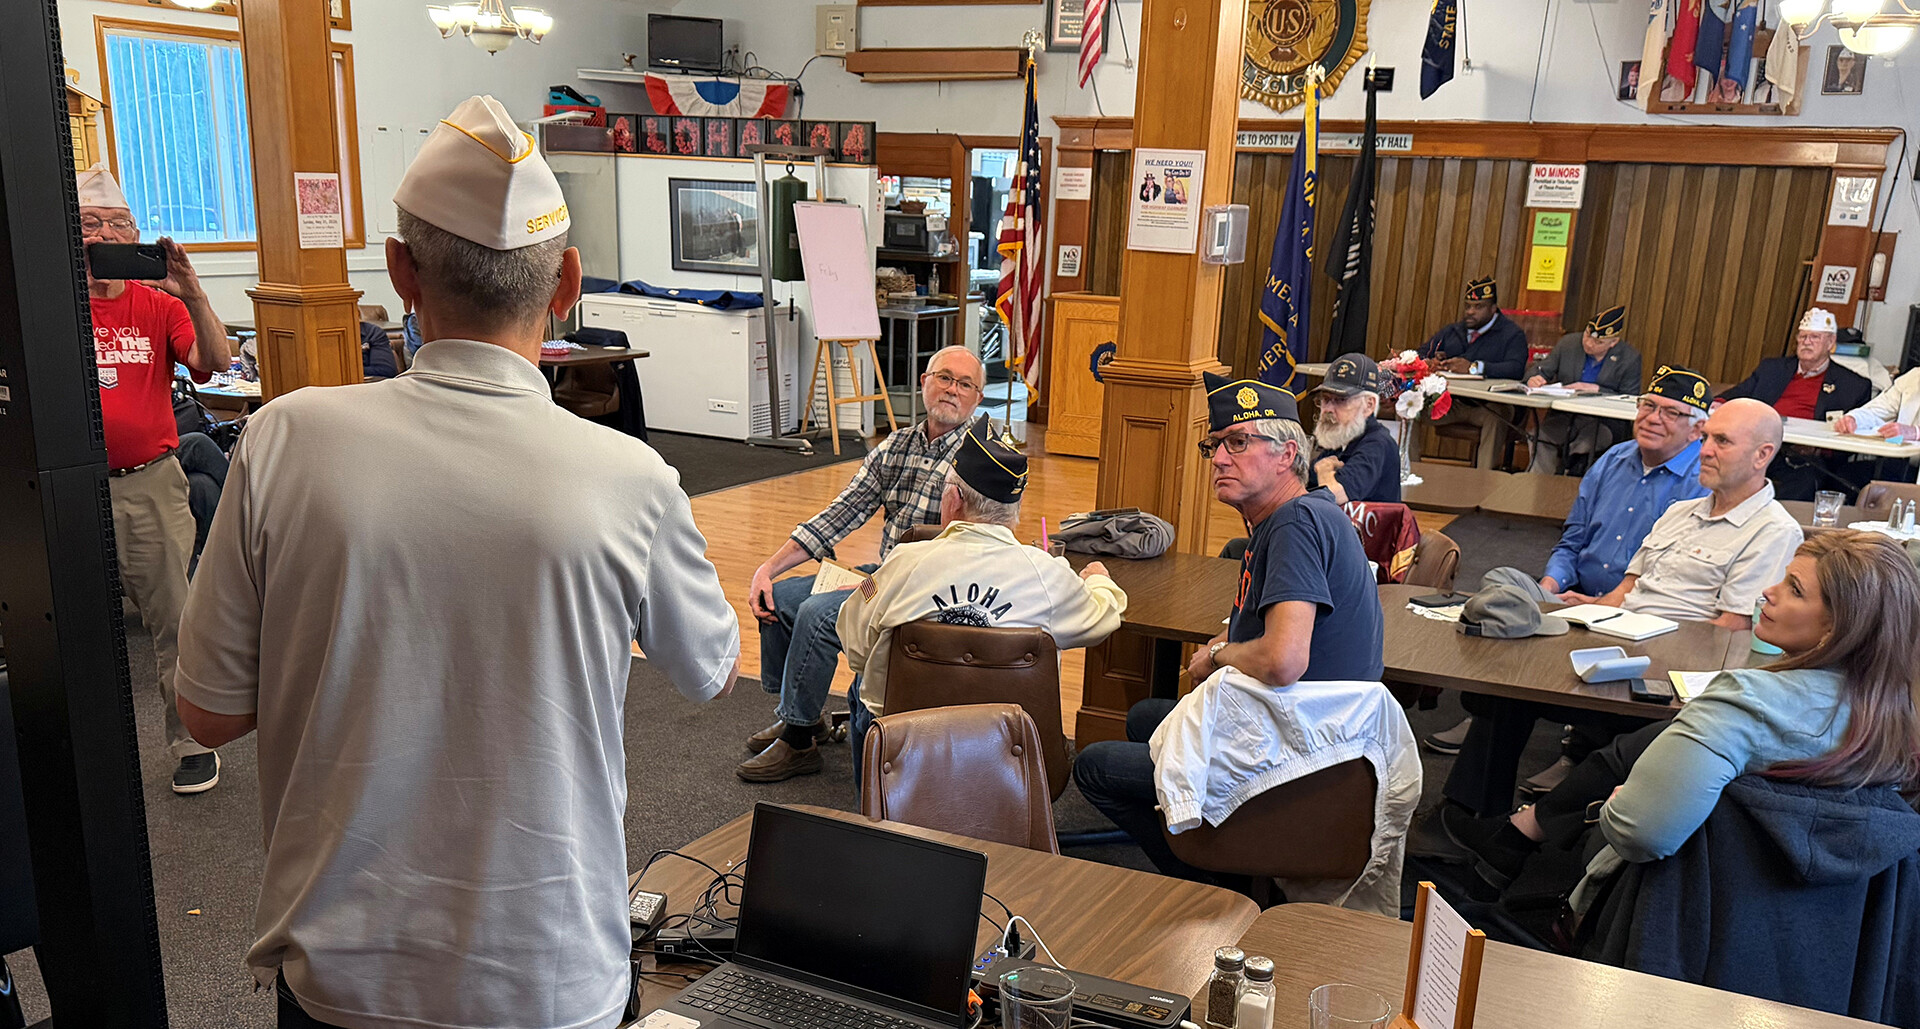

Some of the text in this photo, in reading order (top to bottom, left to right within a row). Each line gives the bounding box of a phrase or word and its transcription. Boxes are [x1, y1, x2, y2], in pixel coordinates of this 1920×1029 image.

[1272, 9, 1301, 35] US
[1439, 5, 1456, 49] STATE
[1241, 64, 1307, 93] LEGIO
[1248, 134, 1257, 145] TO
[1258, 134, 1279, 146] POST
[1280, 134, 1294, 146] 104
[1387, 136, 1408, 149] HALL
[1535, 167, 1580, 178] NO MINORS
[111, 326, 140, 340] you
[118, 336, 152, 351] THE
[96, 350, 155, 364] LENGE?
[1344, 501, 1378, 538] MC
[932, 583, 1013, 621] ALOHA
